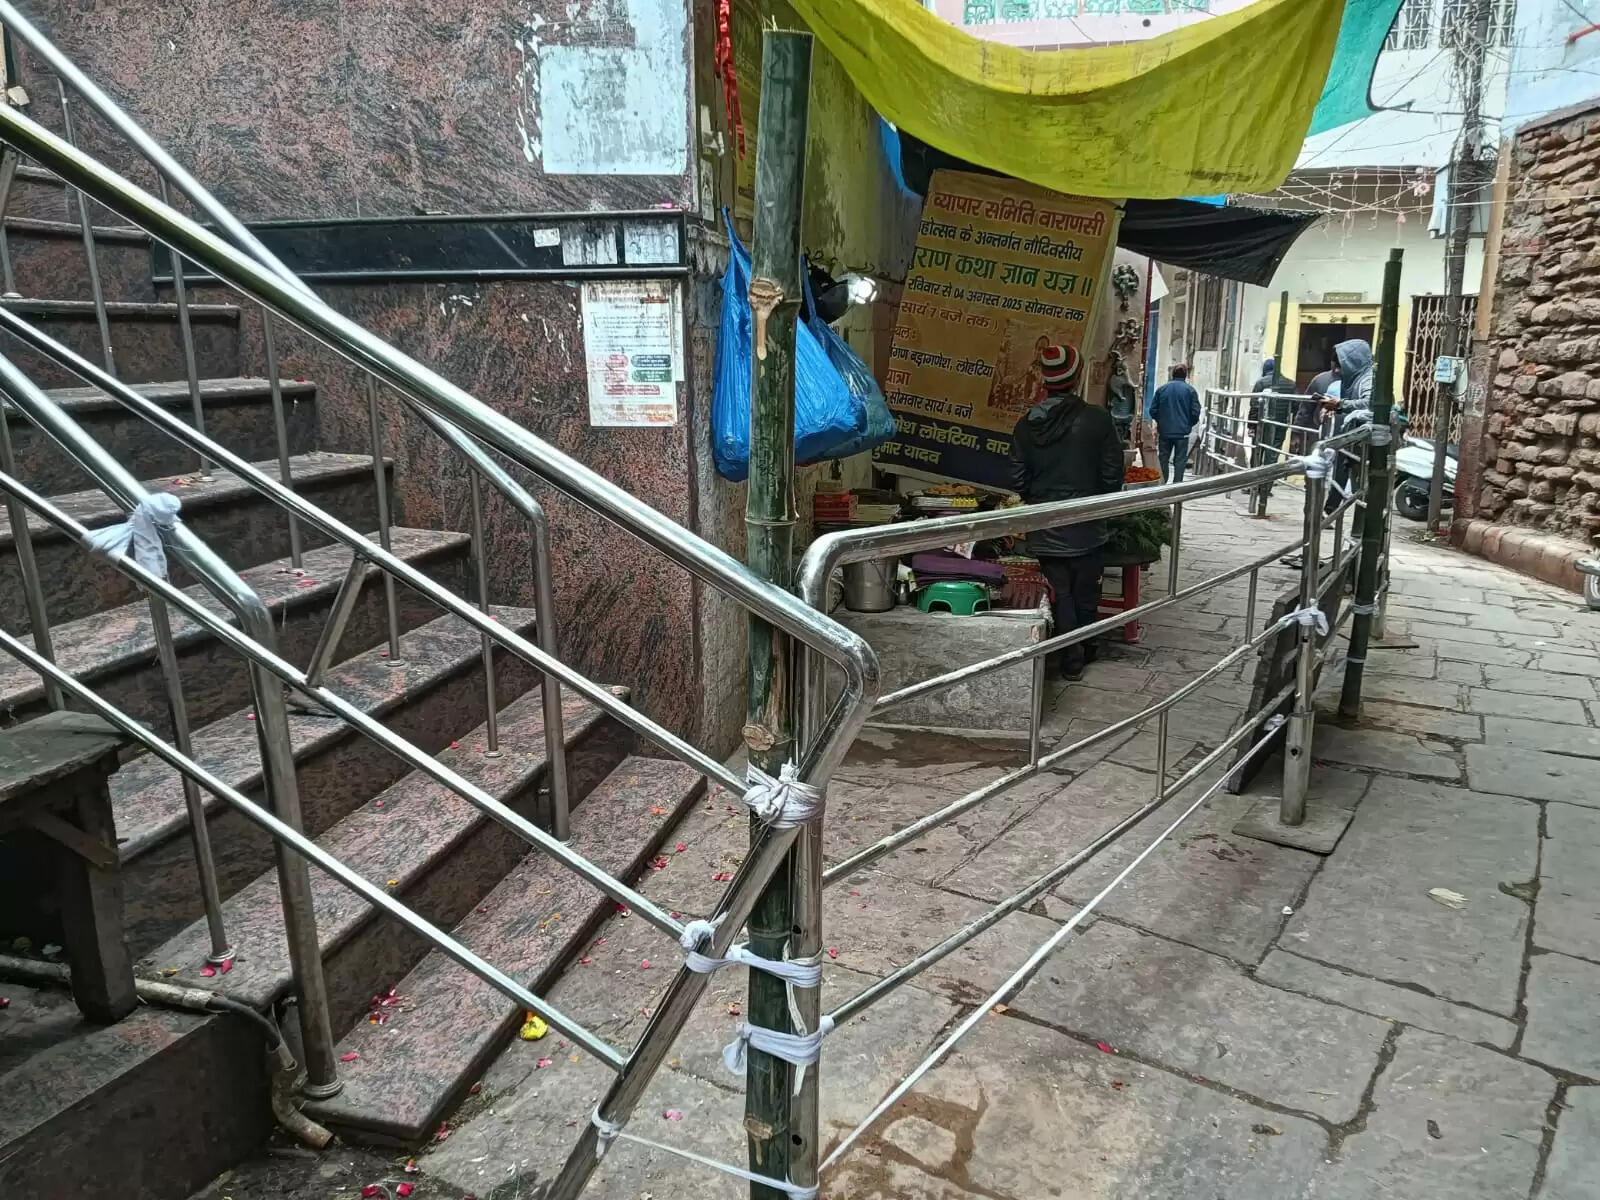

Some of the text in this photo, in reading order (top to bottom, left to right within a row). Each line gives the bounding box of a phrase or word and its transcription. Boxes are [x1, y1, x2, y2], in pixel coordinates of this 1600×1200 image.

[918, 216, 957, 240] होत्सव
[959, 223, 973, 242] के
[1038, 210, 1105, 237] वाराणसी
[955, 254, 997, 279] कथा
[1000, 262, 1040, 287] ज्ञान
[1043, 270, 1078, 295] यज्ञ
[907, 276, 1086, 322] रविवार से 04 अगस्त 2025 सोमवार तक
[900, 301, 928, 315] सायं
[929, 307, 936, 318] 7
[939, 307, 964, 323] बजे
[966, 313, 990, 328] तक
[956, 358, 994, 377] लोहटिया
[890, 388, 924, 409] सोमवार
[925, 397, 948, 415] सायं
[955, 402, 973, 419] बजे
[919, 421, 981, 451] लोहटिया,
[904, 445, 942, 464] यादव
